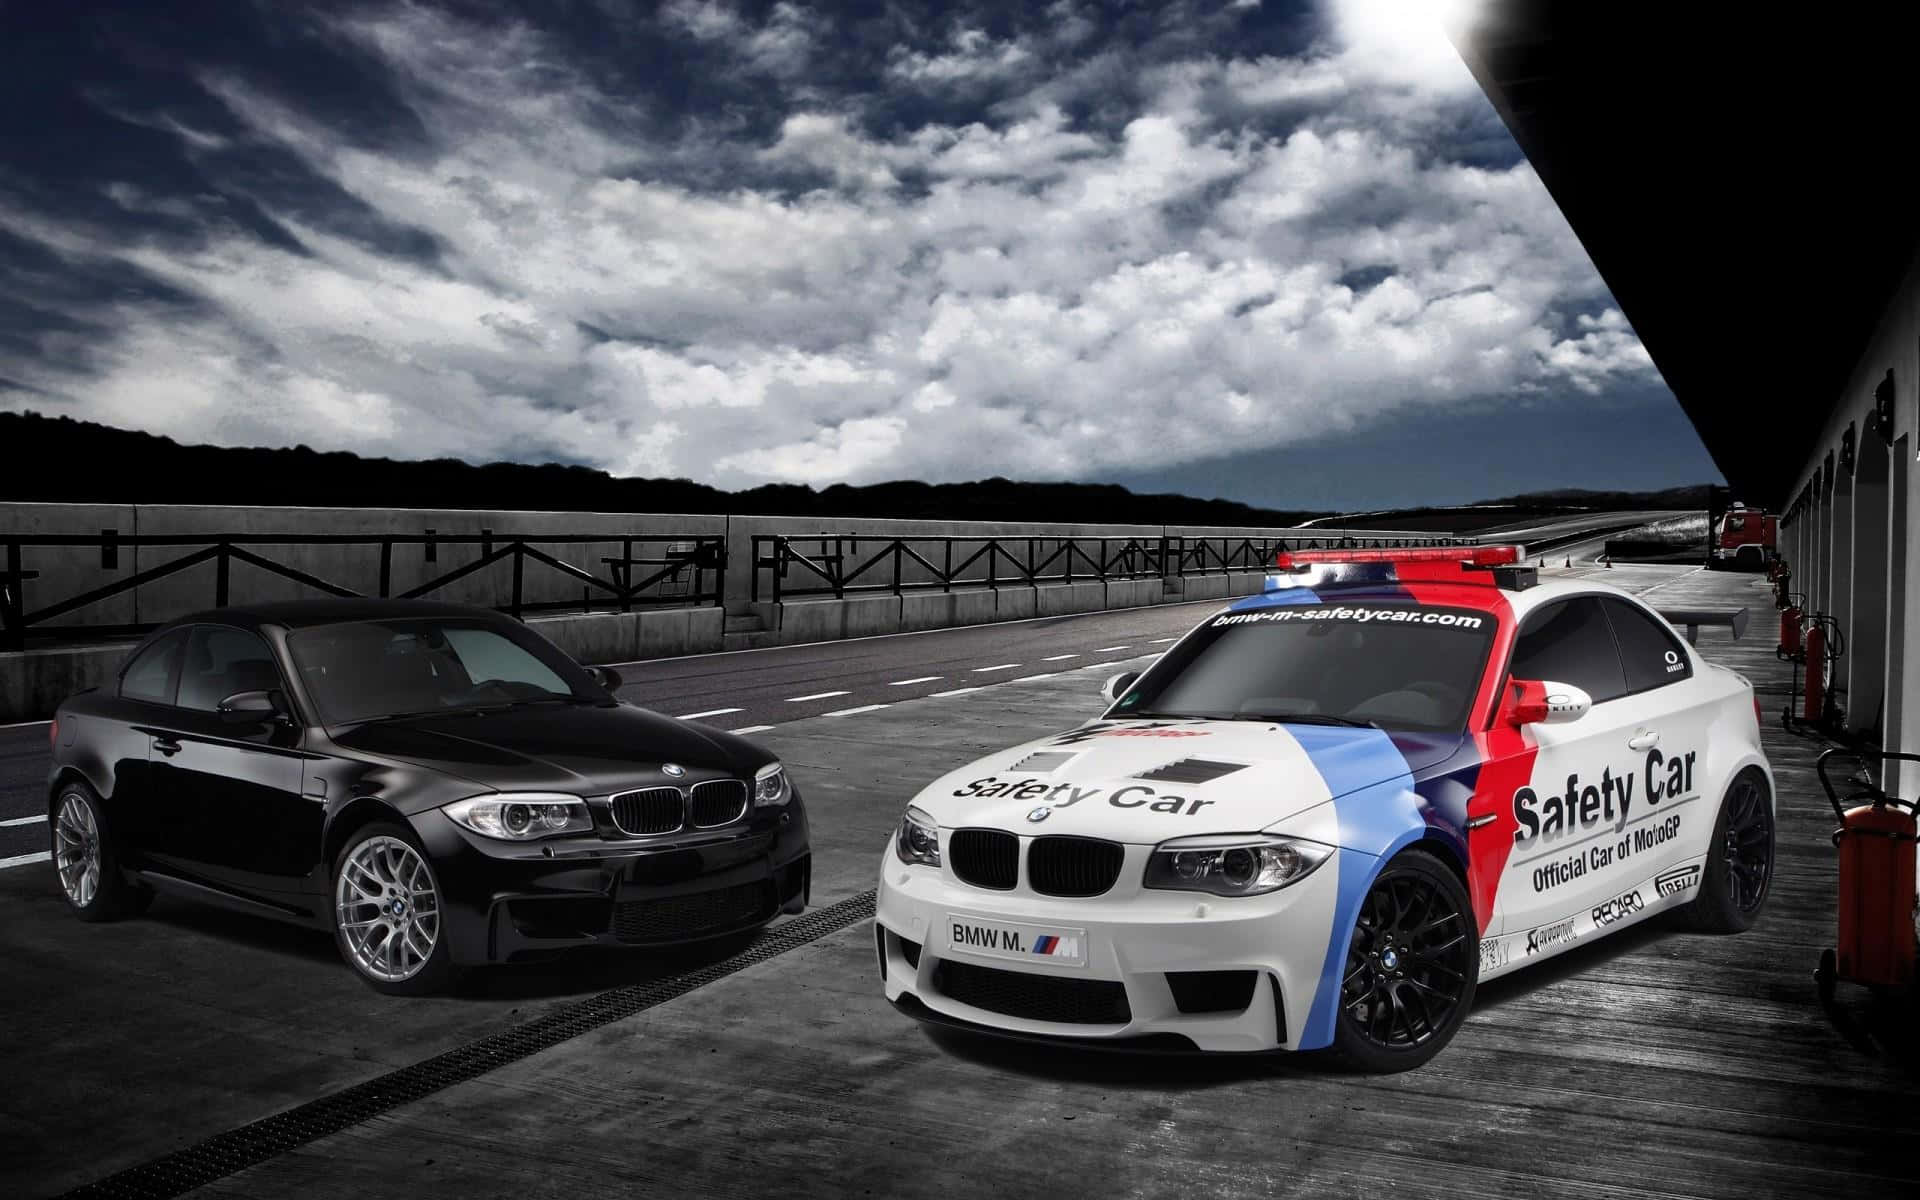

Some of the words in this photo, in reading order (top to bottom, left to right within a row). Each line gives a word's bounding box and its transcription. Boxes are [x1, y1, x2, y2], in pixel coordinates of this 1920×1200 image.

[1212, 607, 1482, 629] bmw-m-safetycar.com
[953, 776, 1104, 808] Safety
[1109, 785, 1216, 816] Car
[1513, 764, 1634, 850] Safety
[1645, 748, 1696, 805] Car
[1533, 851, 1587, 893] Official
[1590, 846, 1613, 871] Car
[1618, 833, 1631, 860] of
[1634, 814, 1681, 853] MotoGP
[1655, 864, 1700, 898] PIRELLI
[1592, 890, 1645, 928] RECARO
[953, 923, 998, 949] BMW
